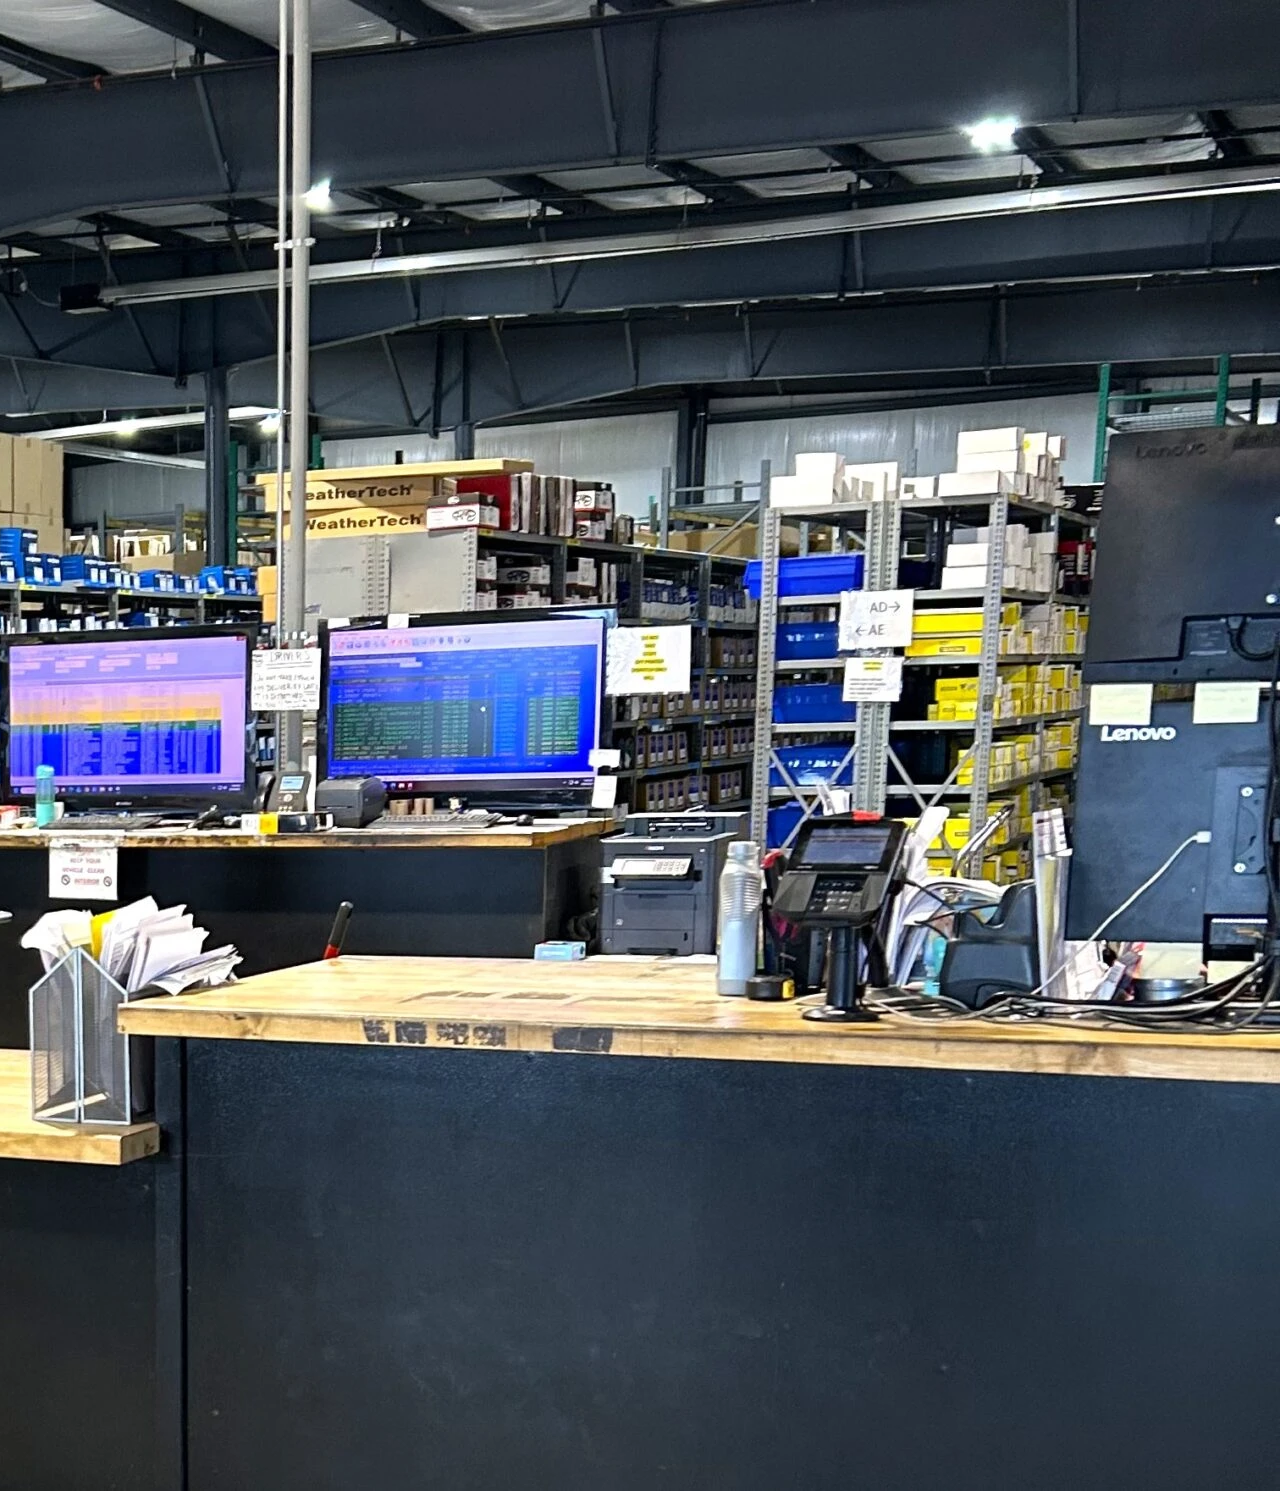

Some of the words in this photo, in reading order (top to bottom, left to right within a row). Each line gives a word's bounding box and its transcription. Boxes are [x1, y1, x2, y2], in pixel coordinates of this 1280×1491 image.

[288, 484, 413, 501] eatherTech
[870, 602, 888, 613] AD
[868, 624, 885, 635] AE
[1100, 726, 1176, 742] Lenovo
